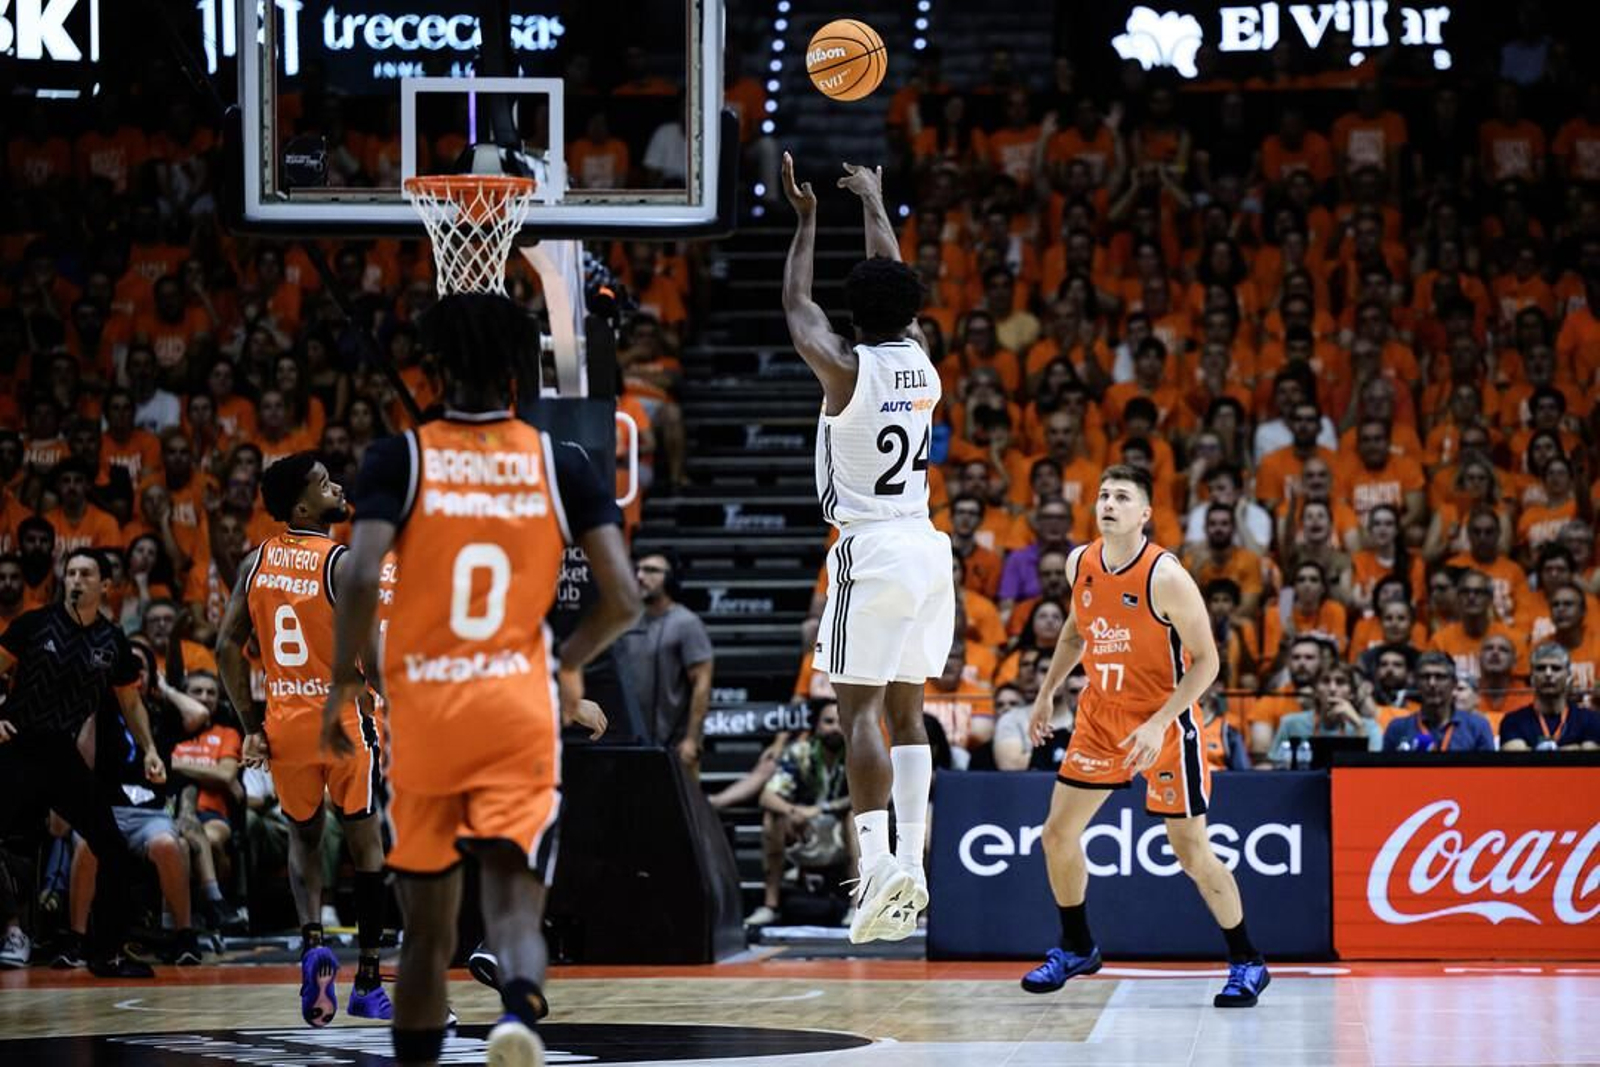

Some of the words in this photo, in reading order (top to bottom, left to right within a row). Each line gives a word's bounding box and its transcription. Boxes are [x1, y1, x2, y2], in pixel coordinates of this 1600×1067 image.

[1219, 2, 1280, 51] El
[874, 424, 930, 496] 24
[267, 546, 319, 572] MONTERO
[450, 543, 511, 641] 0
[273, 604, 309, 667] 8
[1094, 663, 1125, 692] 77
